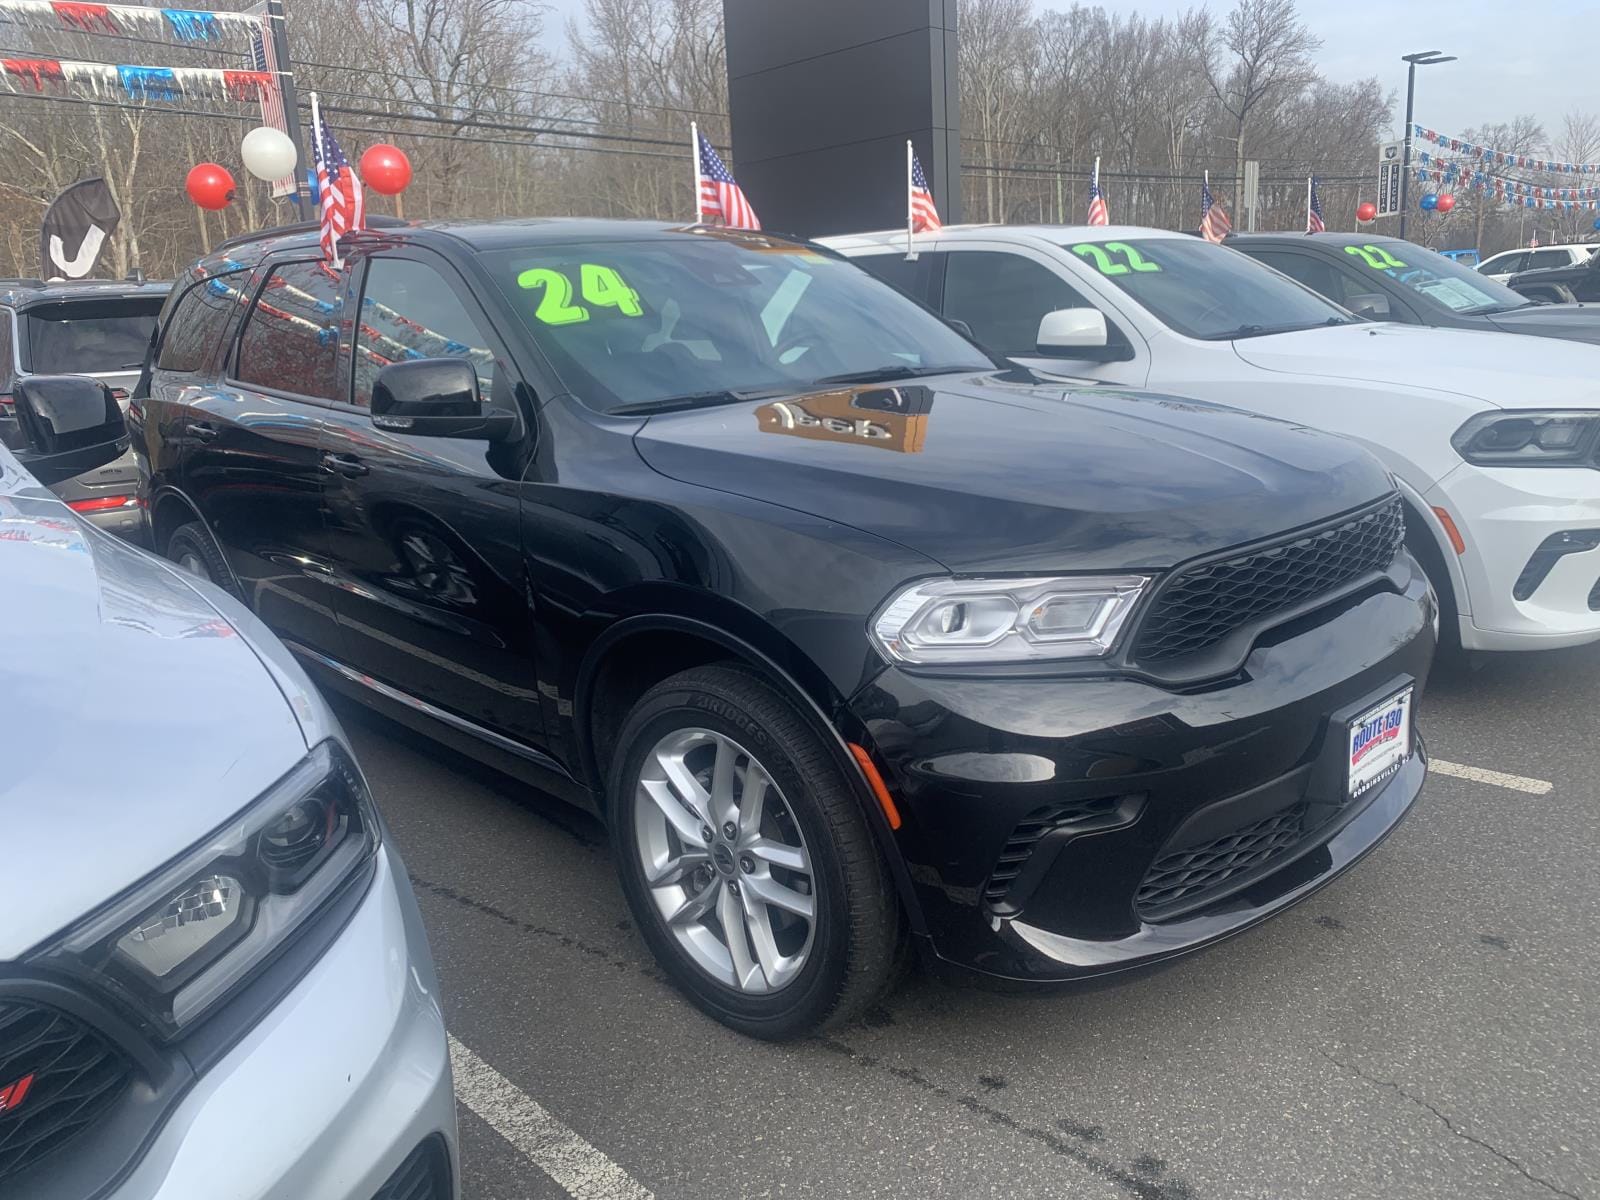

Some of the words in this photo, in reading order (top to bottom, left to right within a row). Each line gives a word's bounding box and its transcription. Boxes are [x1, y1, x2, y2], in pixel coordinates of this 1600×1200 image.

[1380, 166, 1388, 212] COMMERCIAL
[1391, 166, 1399, 210] TRUCKS
[1072, 242, 1162, 275] 22
[1344, 244, 1408, 270] 22
[518, 264, 643, 325] 24
[1353, 716, 1384, 755] ROUTE
[1385, 708, 1402, 733] 130
